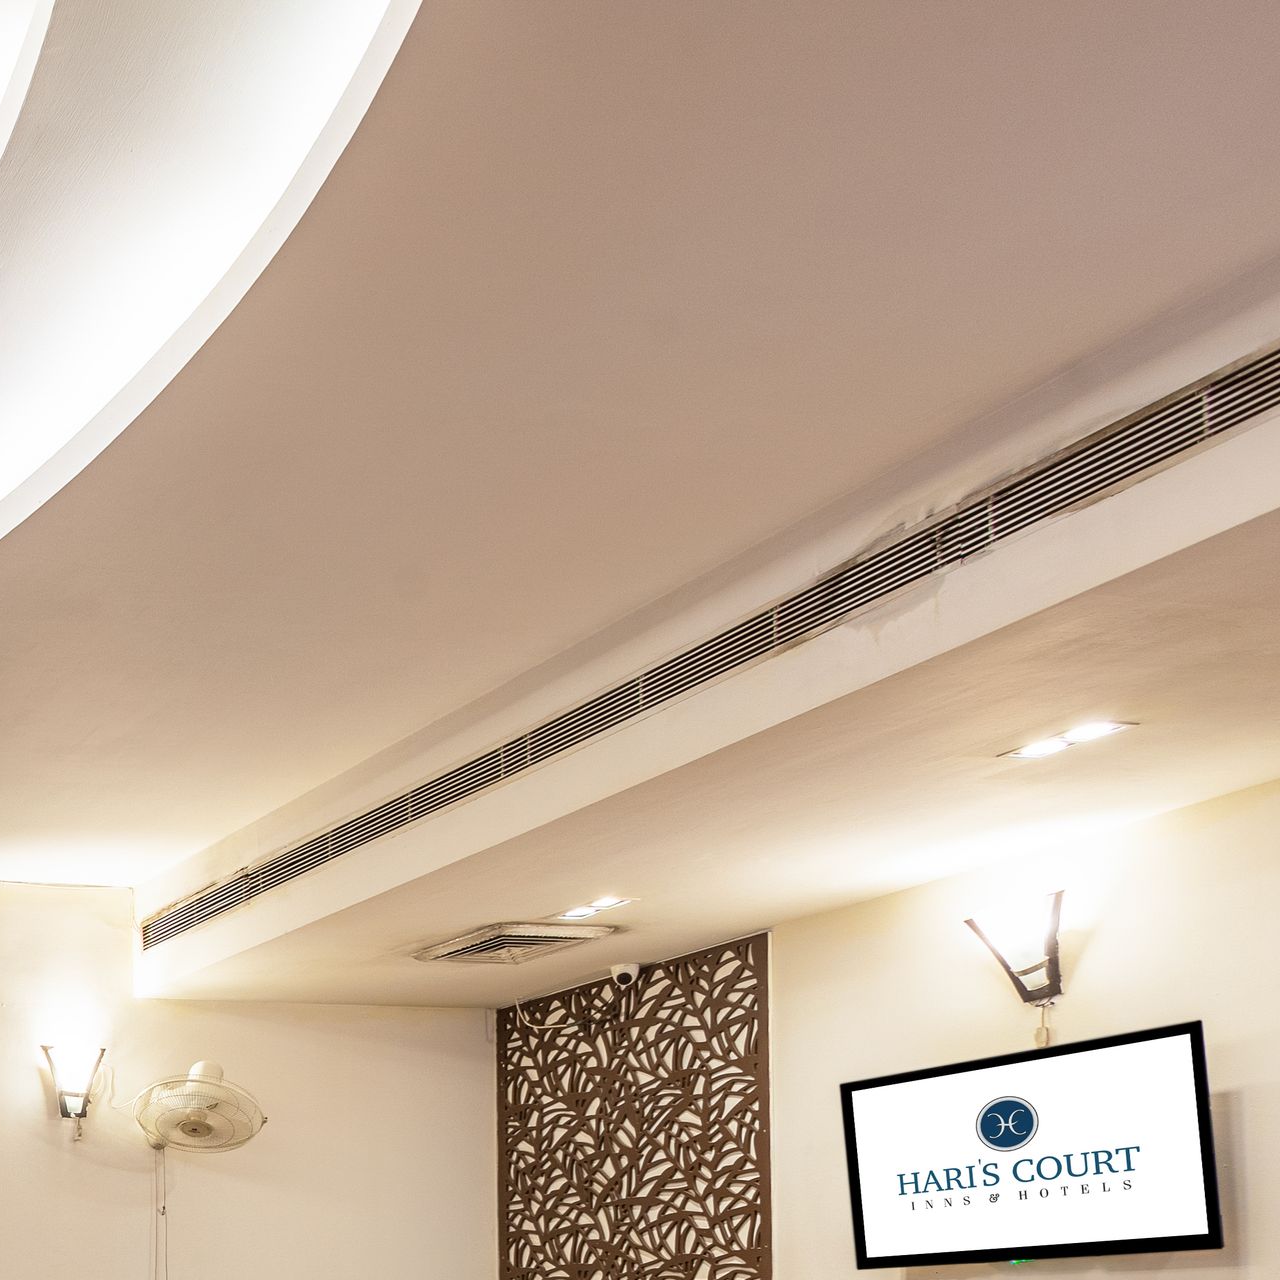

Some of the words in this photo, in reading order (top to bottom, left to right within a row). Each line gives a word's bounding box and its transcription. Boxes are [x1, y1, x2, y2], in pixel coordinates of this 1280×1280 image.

[897, 1158, 1000, 1196] HARI'S
[1012, 1146, 1141, 1183] COURT
[911, 1196, 971, 1211] INNS
[989, 1193, 1000, 1203] &
[1018, 1180, 1133, 1201] HOTELS
